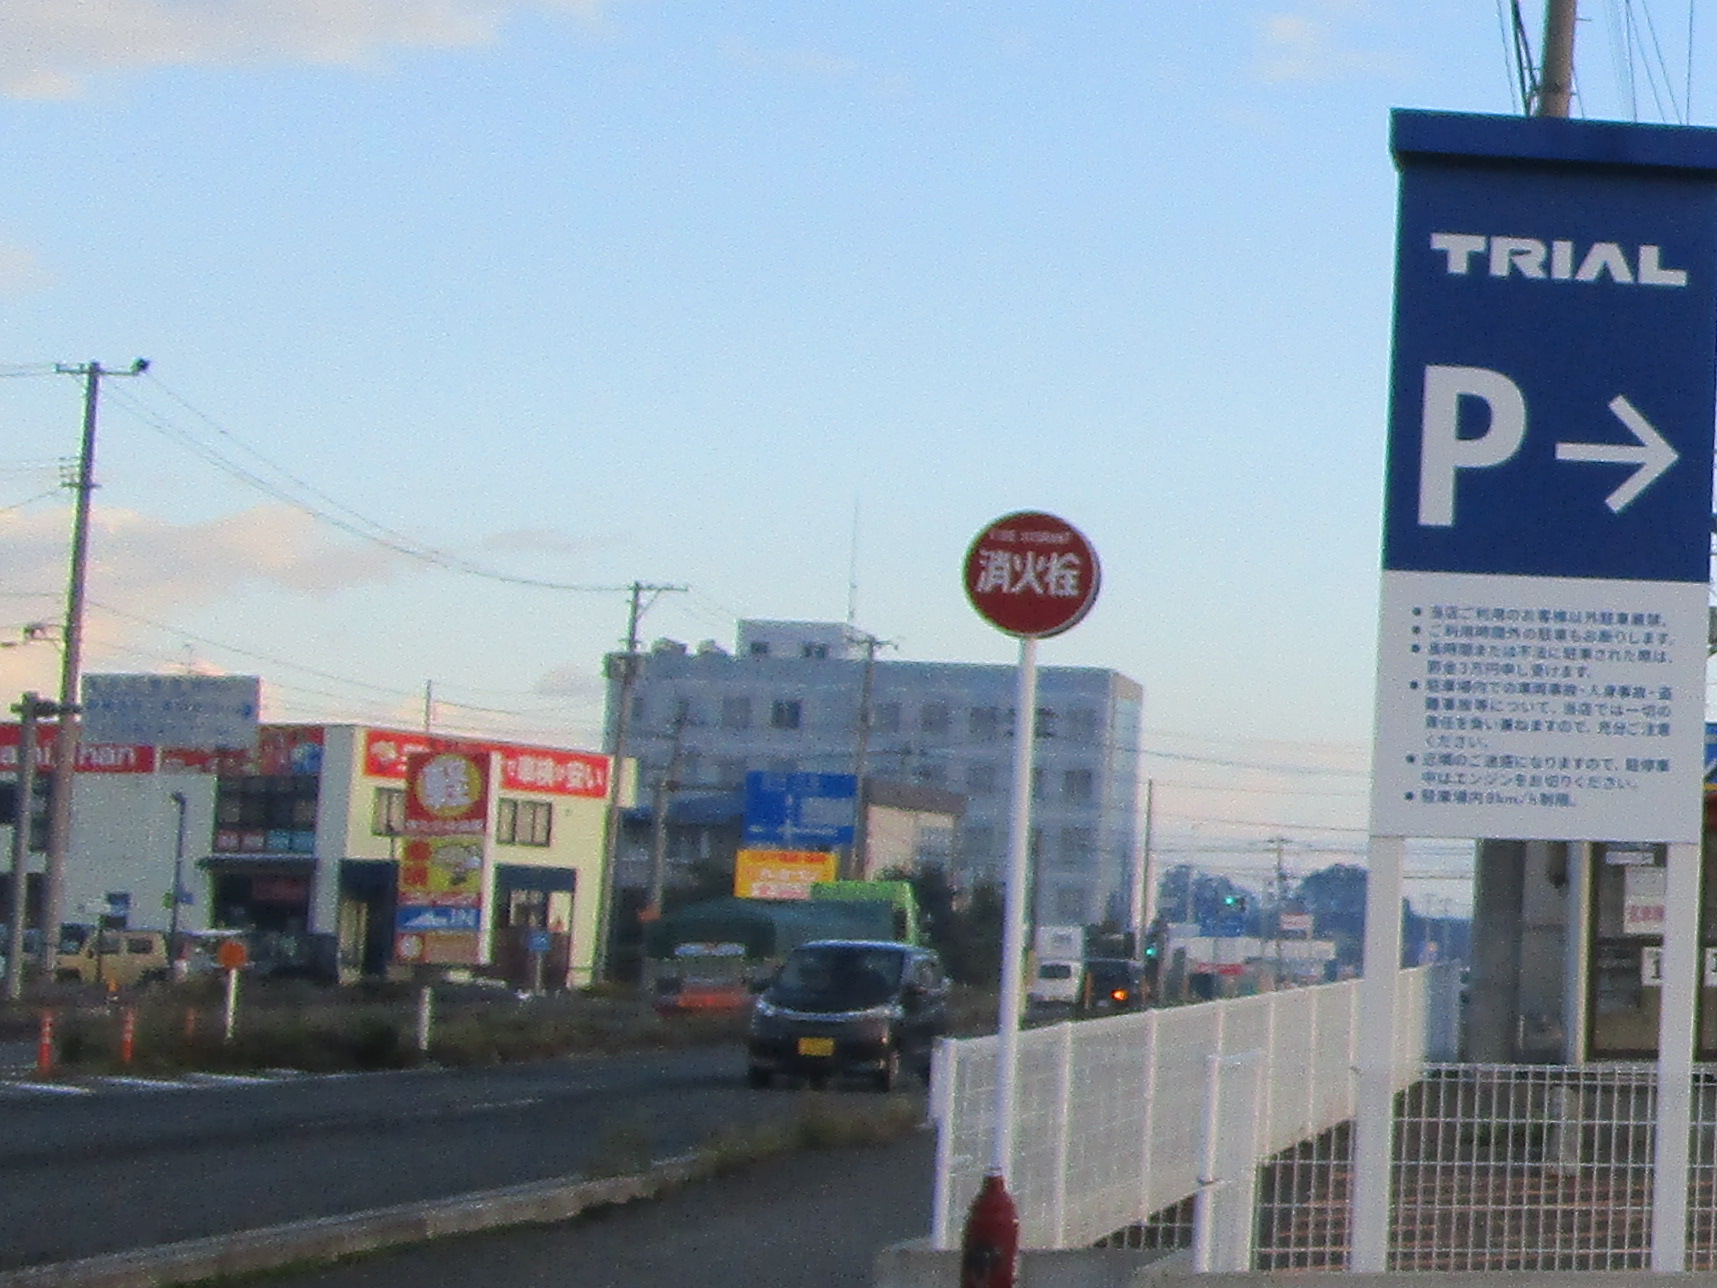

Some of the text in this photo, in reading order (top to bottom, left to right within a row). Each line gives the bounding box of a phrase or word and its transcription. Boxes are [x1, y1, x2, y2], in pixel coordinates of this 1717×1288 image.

[1430, 232, 1687, 286] TRIAL
[1418, 364, 1529, 527] P
[976, 550, 1080, 596] 消火栓
